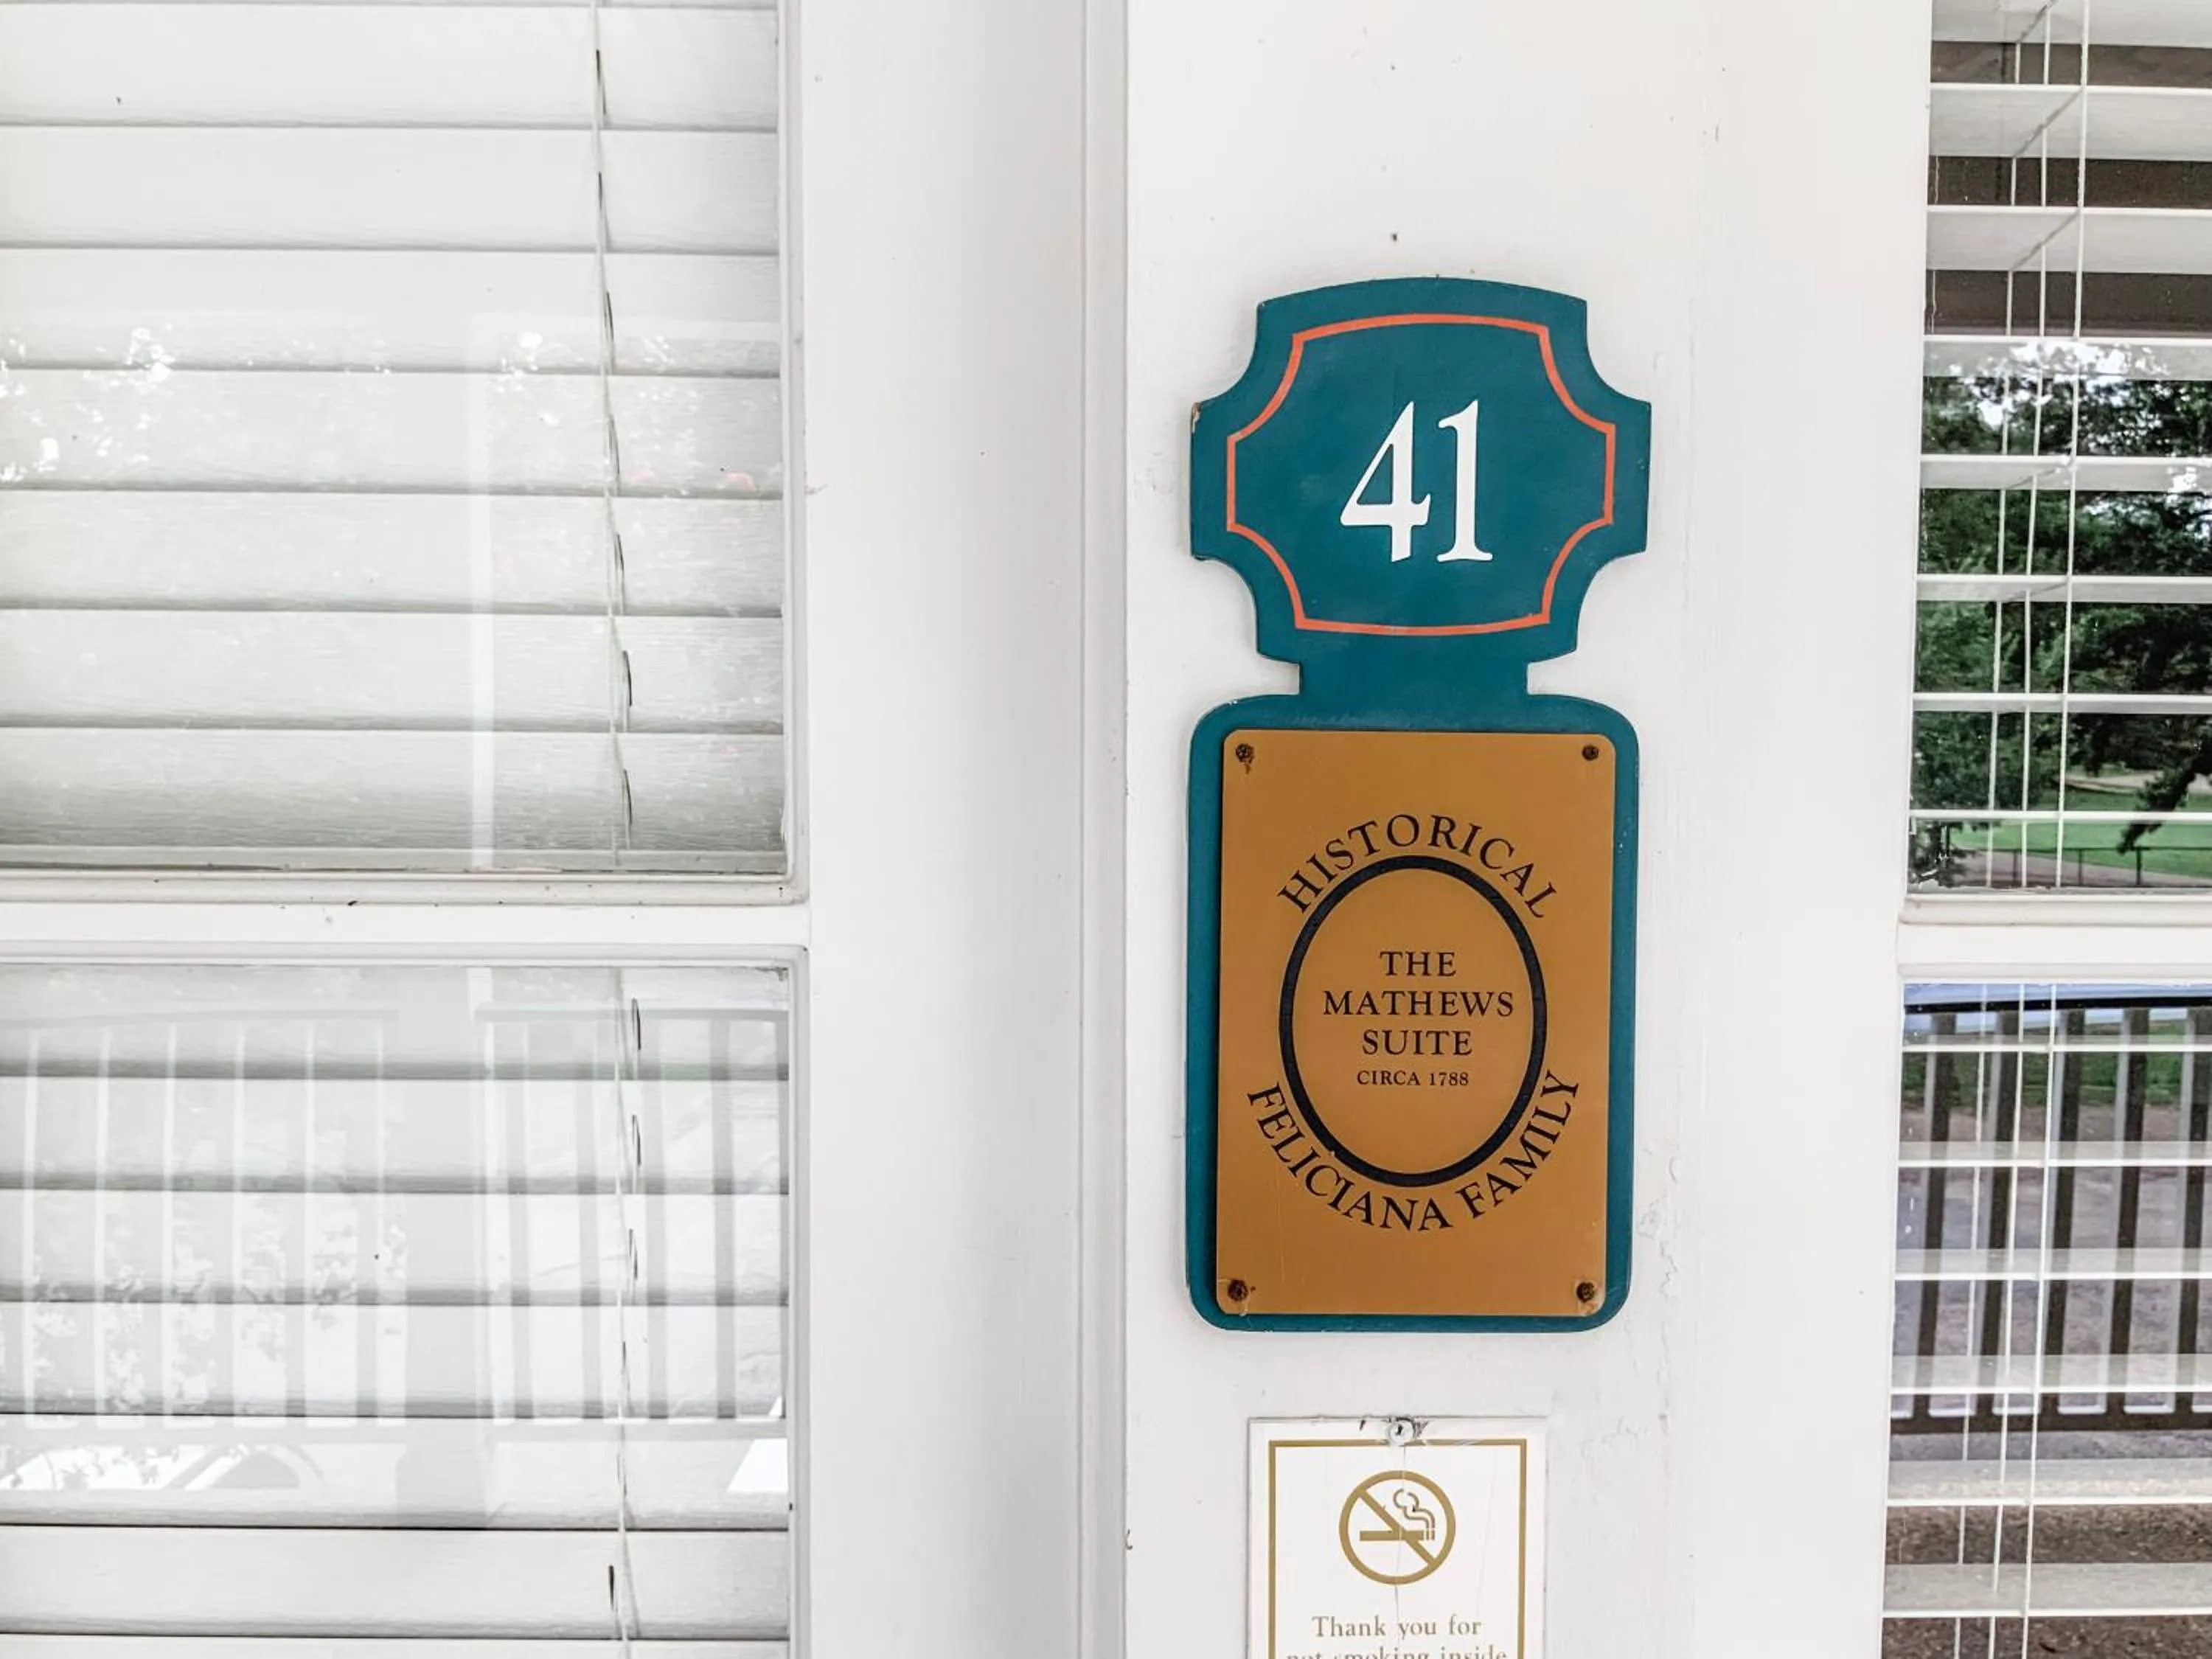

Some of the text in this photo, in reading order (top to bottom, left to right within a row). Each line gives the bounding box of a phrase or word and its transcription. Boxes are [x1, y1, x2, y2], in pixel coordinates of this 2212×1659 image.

[1340, 399, 1493, 563] 41
[1276, 814, 1557, 919] HISTORICAL
[1380, 951, 1456, 977] THE
[1324, 991, 1514, 1017] MATHEWS
[1362, 1029, 1472, 1056] SUITE
[1357, 1070, 1469, 1086] CIRCA 1788
[1247, 1070, 1580, 1232] FELICIANA FAMILY
[1312, 1614, 1482, 1641] Thank you for
